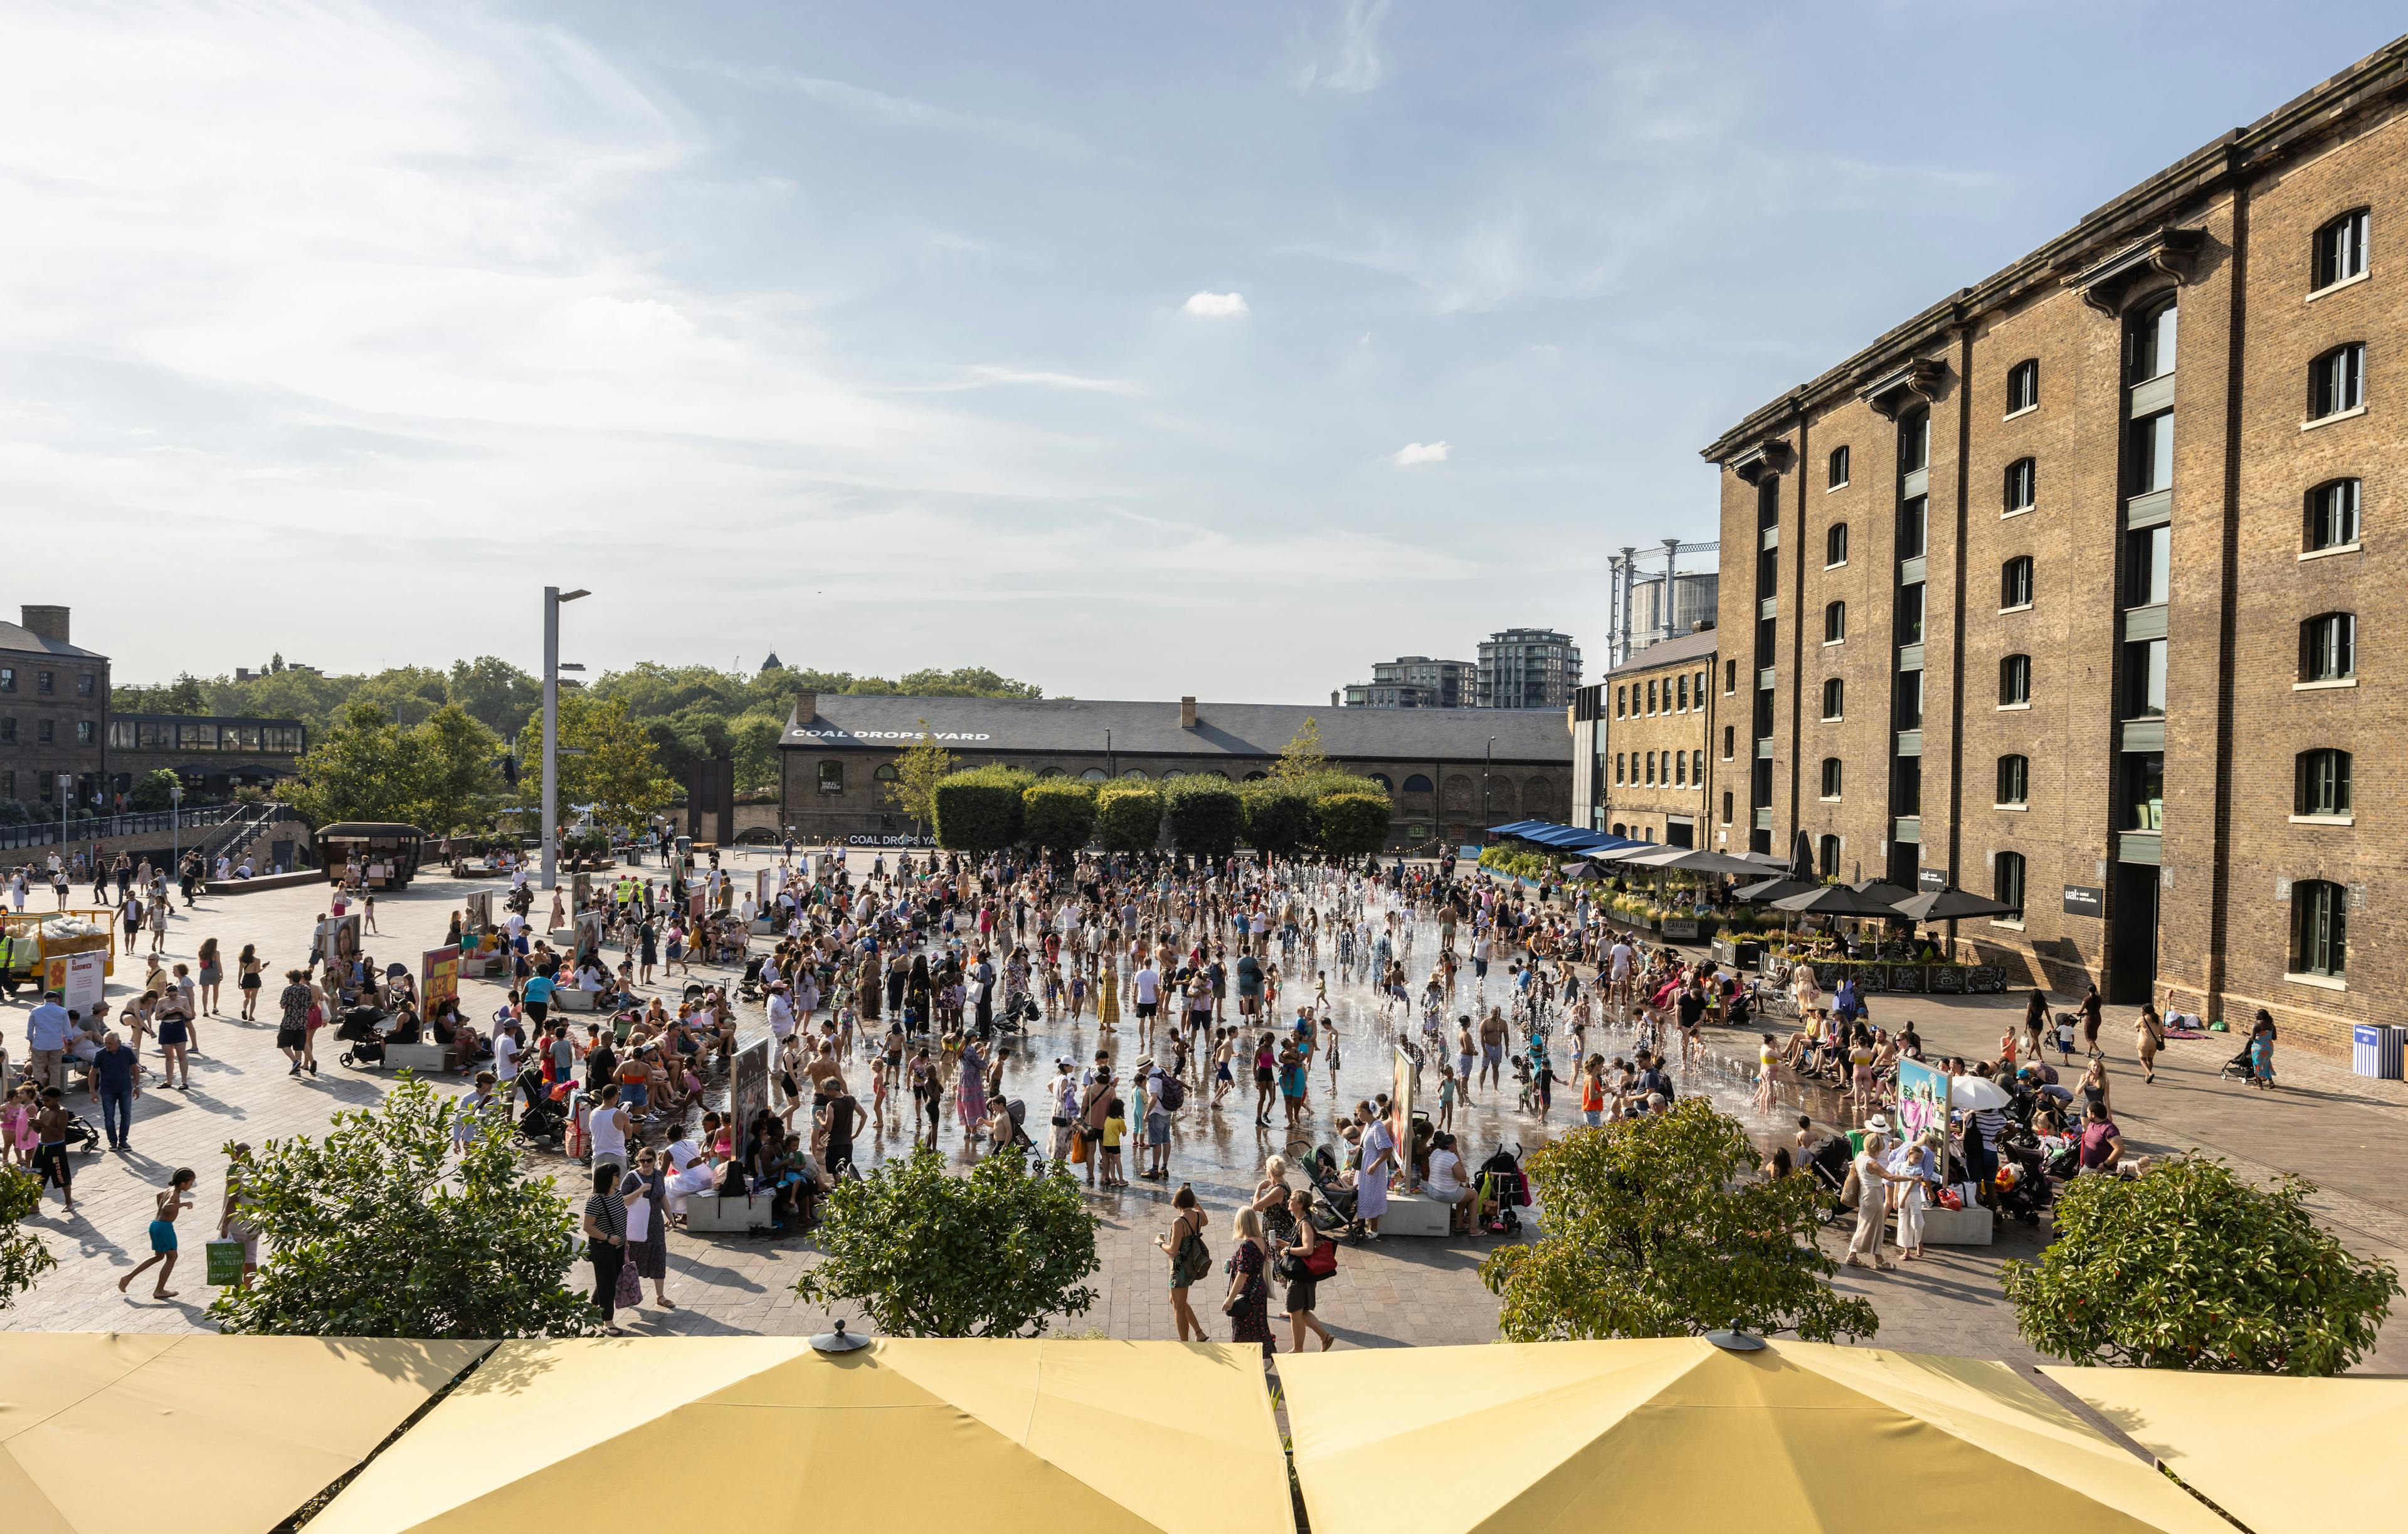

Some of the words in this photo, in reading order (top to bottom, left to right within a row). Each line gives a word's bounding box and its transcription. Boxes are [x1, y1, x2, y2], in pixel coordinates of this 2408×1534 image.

[791, 729, 848, 738] COAL
[853, 731, 927, 739] DROPS
[850, 835, 880, 844] COAL
[922, 836, 936, 845] YA
[71, 963, 92, 971] HARDWICK
